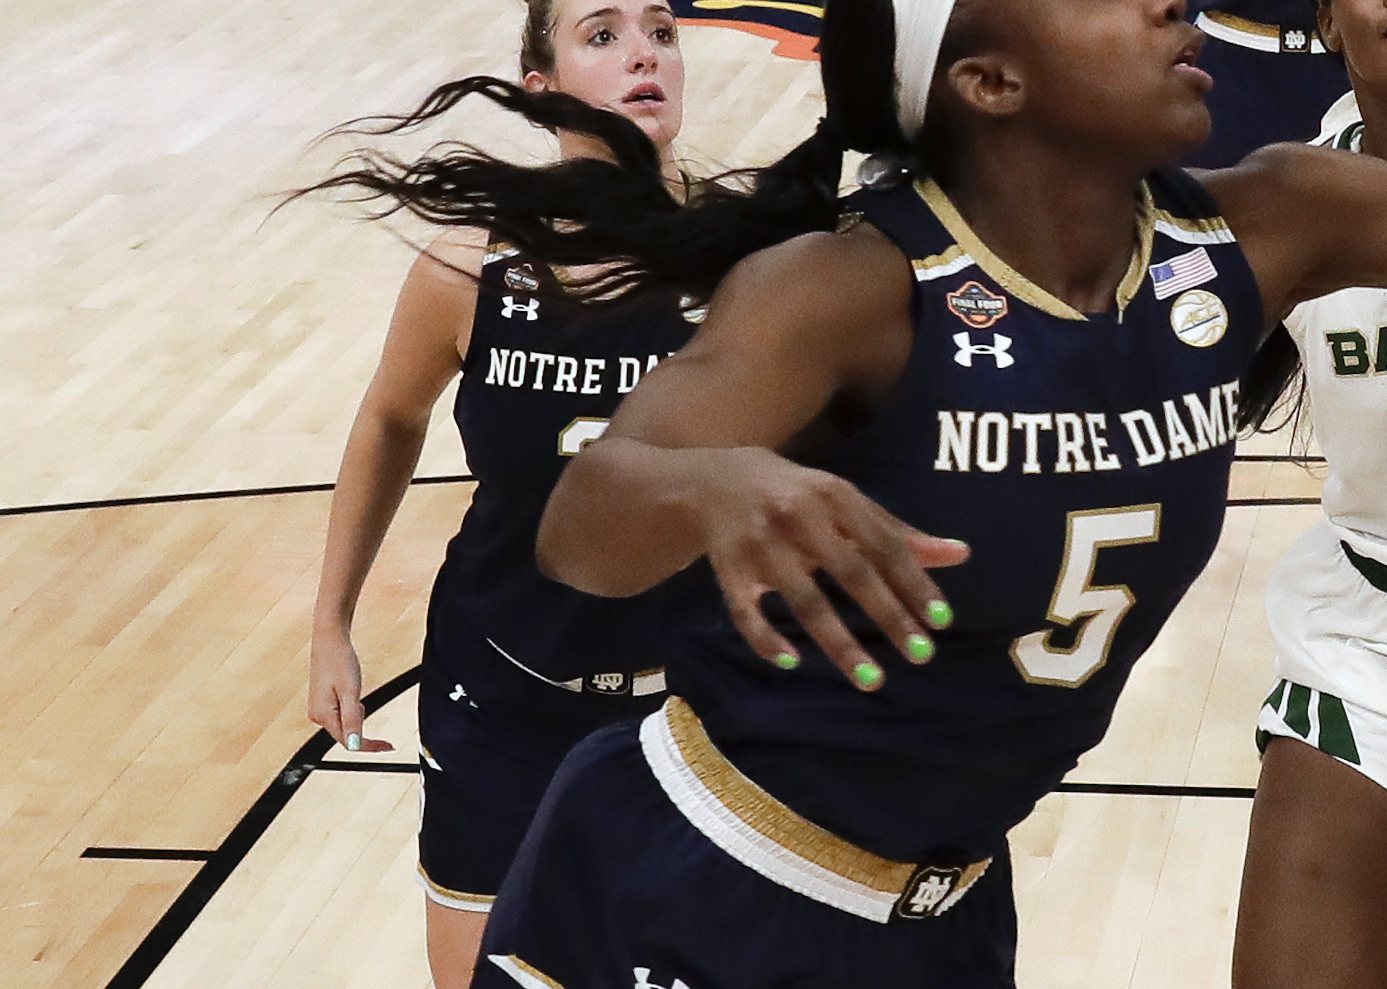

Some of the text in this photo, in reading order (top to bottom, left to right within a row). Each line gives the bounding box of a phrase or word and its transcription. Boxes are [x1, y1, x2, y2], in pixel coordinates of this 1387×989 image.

[484, 347, 606, 395] NOTRE
[933, 380, 1240, 474] NOTRE DAME
[1008, 503, 1162, 689] 5
